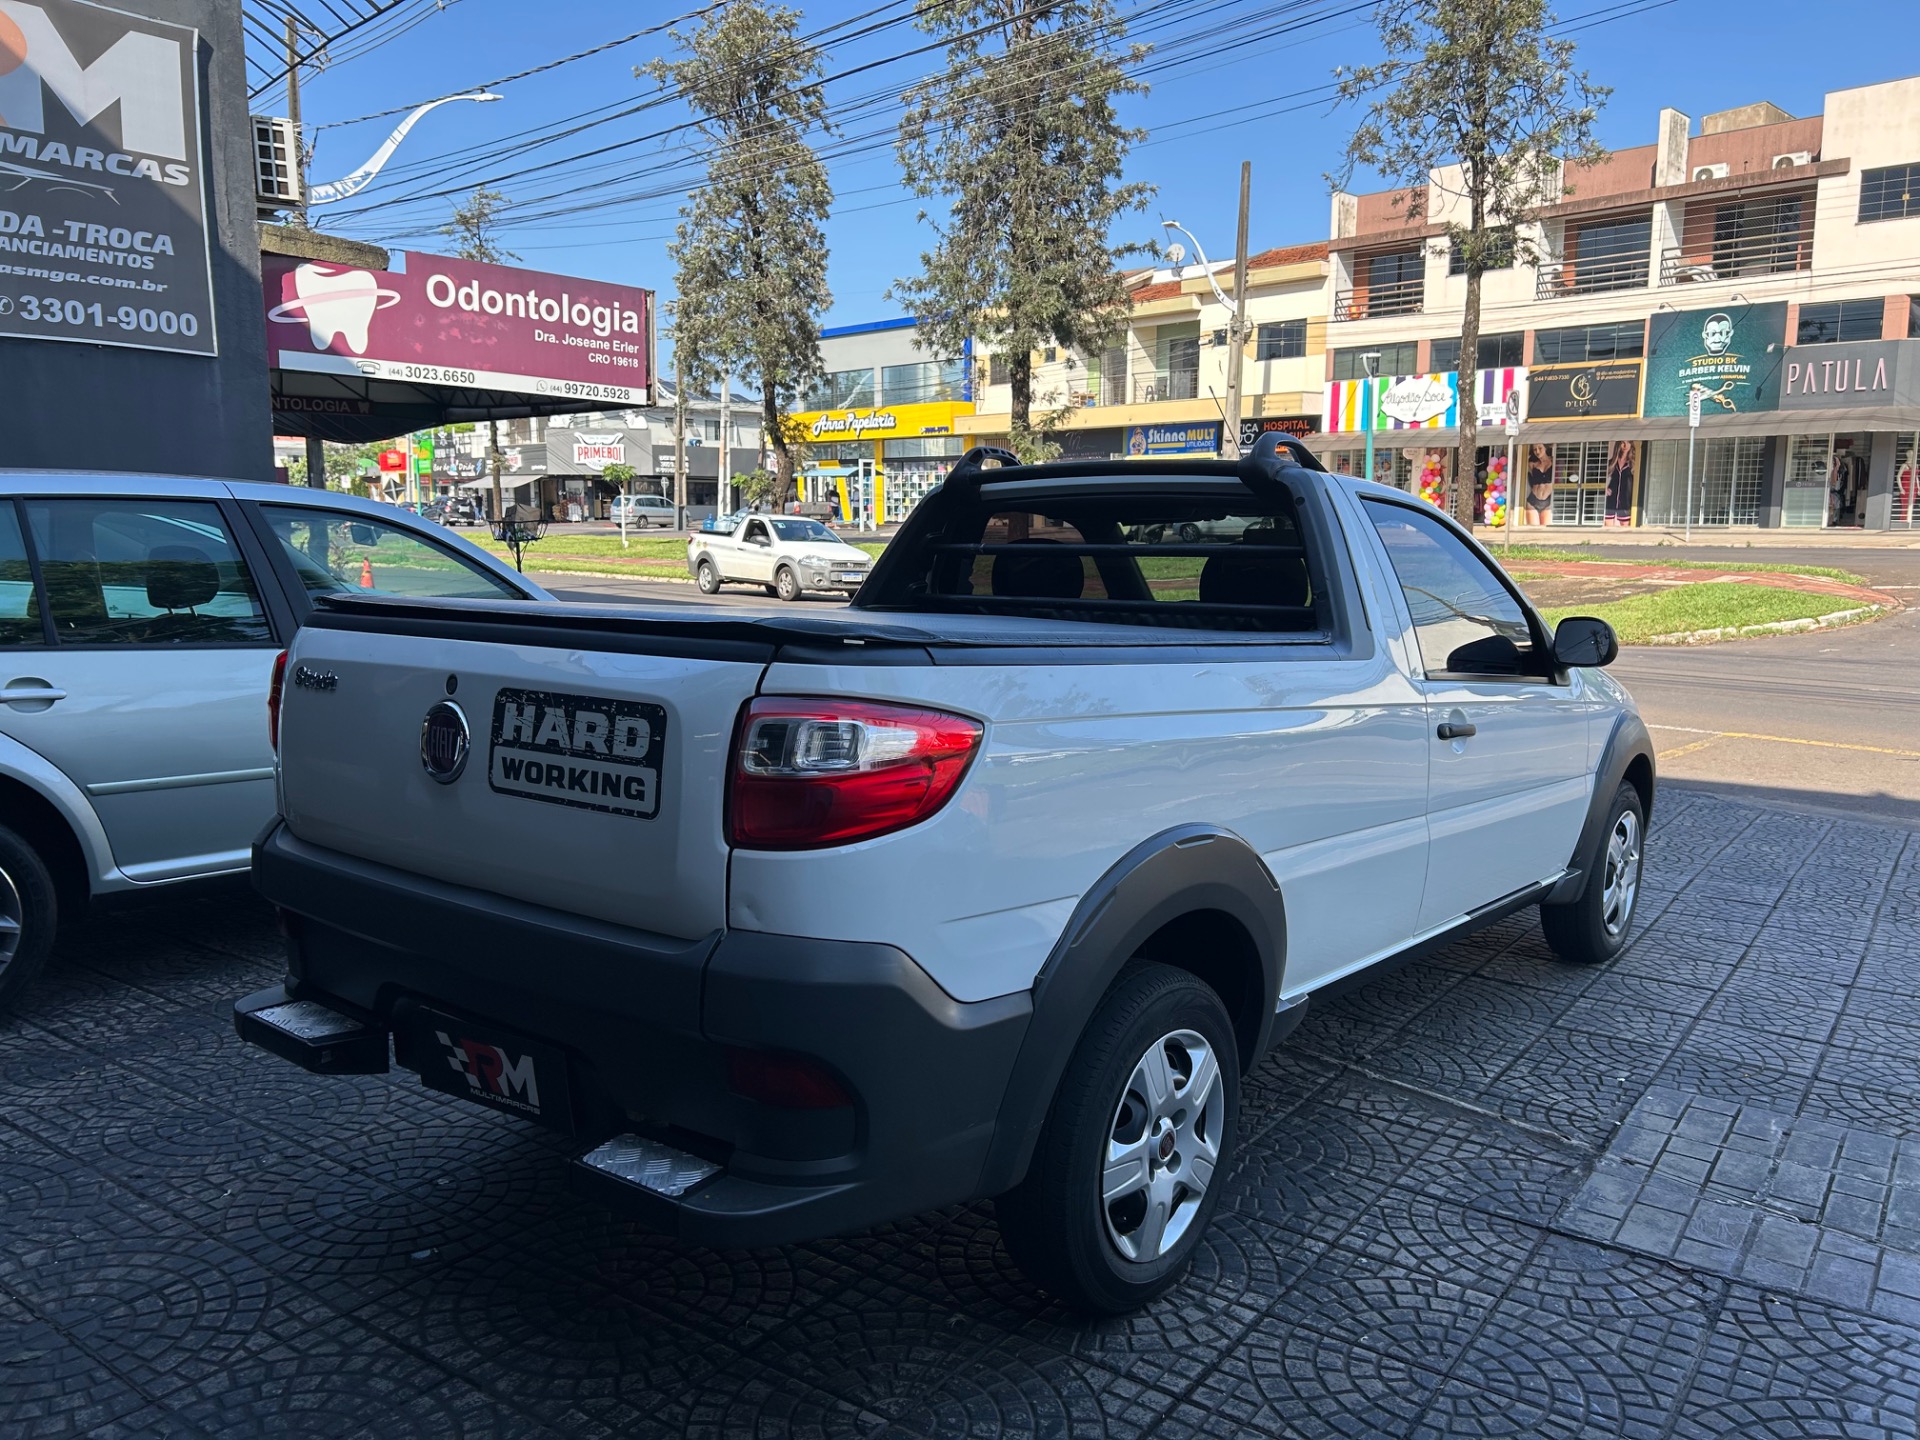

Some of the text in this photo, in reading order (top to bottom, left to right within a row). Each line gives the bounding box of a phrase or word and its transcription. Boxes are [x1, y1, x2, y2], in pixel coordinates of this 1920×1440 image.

[0, 132, 191, 187] MARCAS
[0, 264, 169, 293] asmga.com.br
[19, 295, 198, 337] 3301-9000
[426, 273, 640, 337] Odontologia
[534, 329, 640, 355] Dra. Joseane Erler
[388, 364, 476, 385] (44) 3023.6650
[588, 353, 639, 369] CRO 19618
[1678, 363, 1751, 378] BARBER KELVIN
[1691, 356, 1738, 367] STUDIO BK
[1786, 357, 1888, 395] PATULA
[549, 381, 631, 401] (44) 99720.5928
[812, 410, 897, 440] Anna Papelaria
[1263, 420, 1310, 431] HOSPITAL
[577, 446, 622, 462] PRIMEBOI
[1186, 440, 1215, 449] UTILIDADES
[430, 725, 456, 760] FIAT
[501, 701, 651, 759] HARD
[501, 756, 646, 802] WORKING
[470, 1086, 541, 1116] MULTIMARCAS
